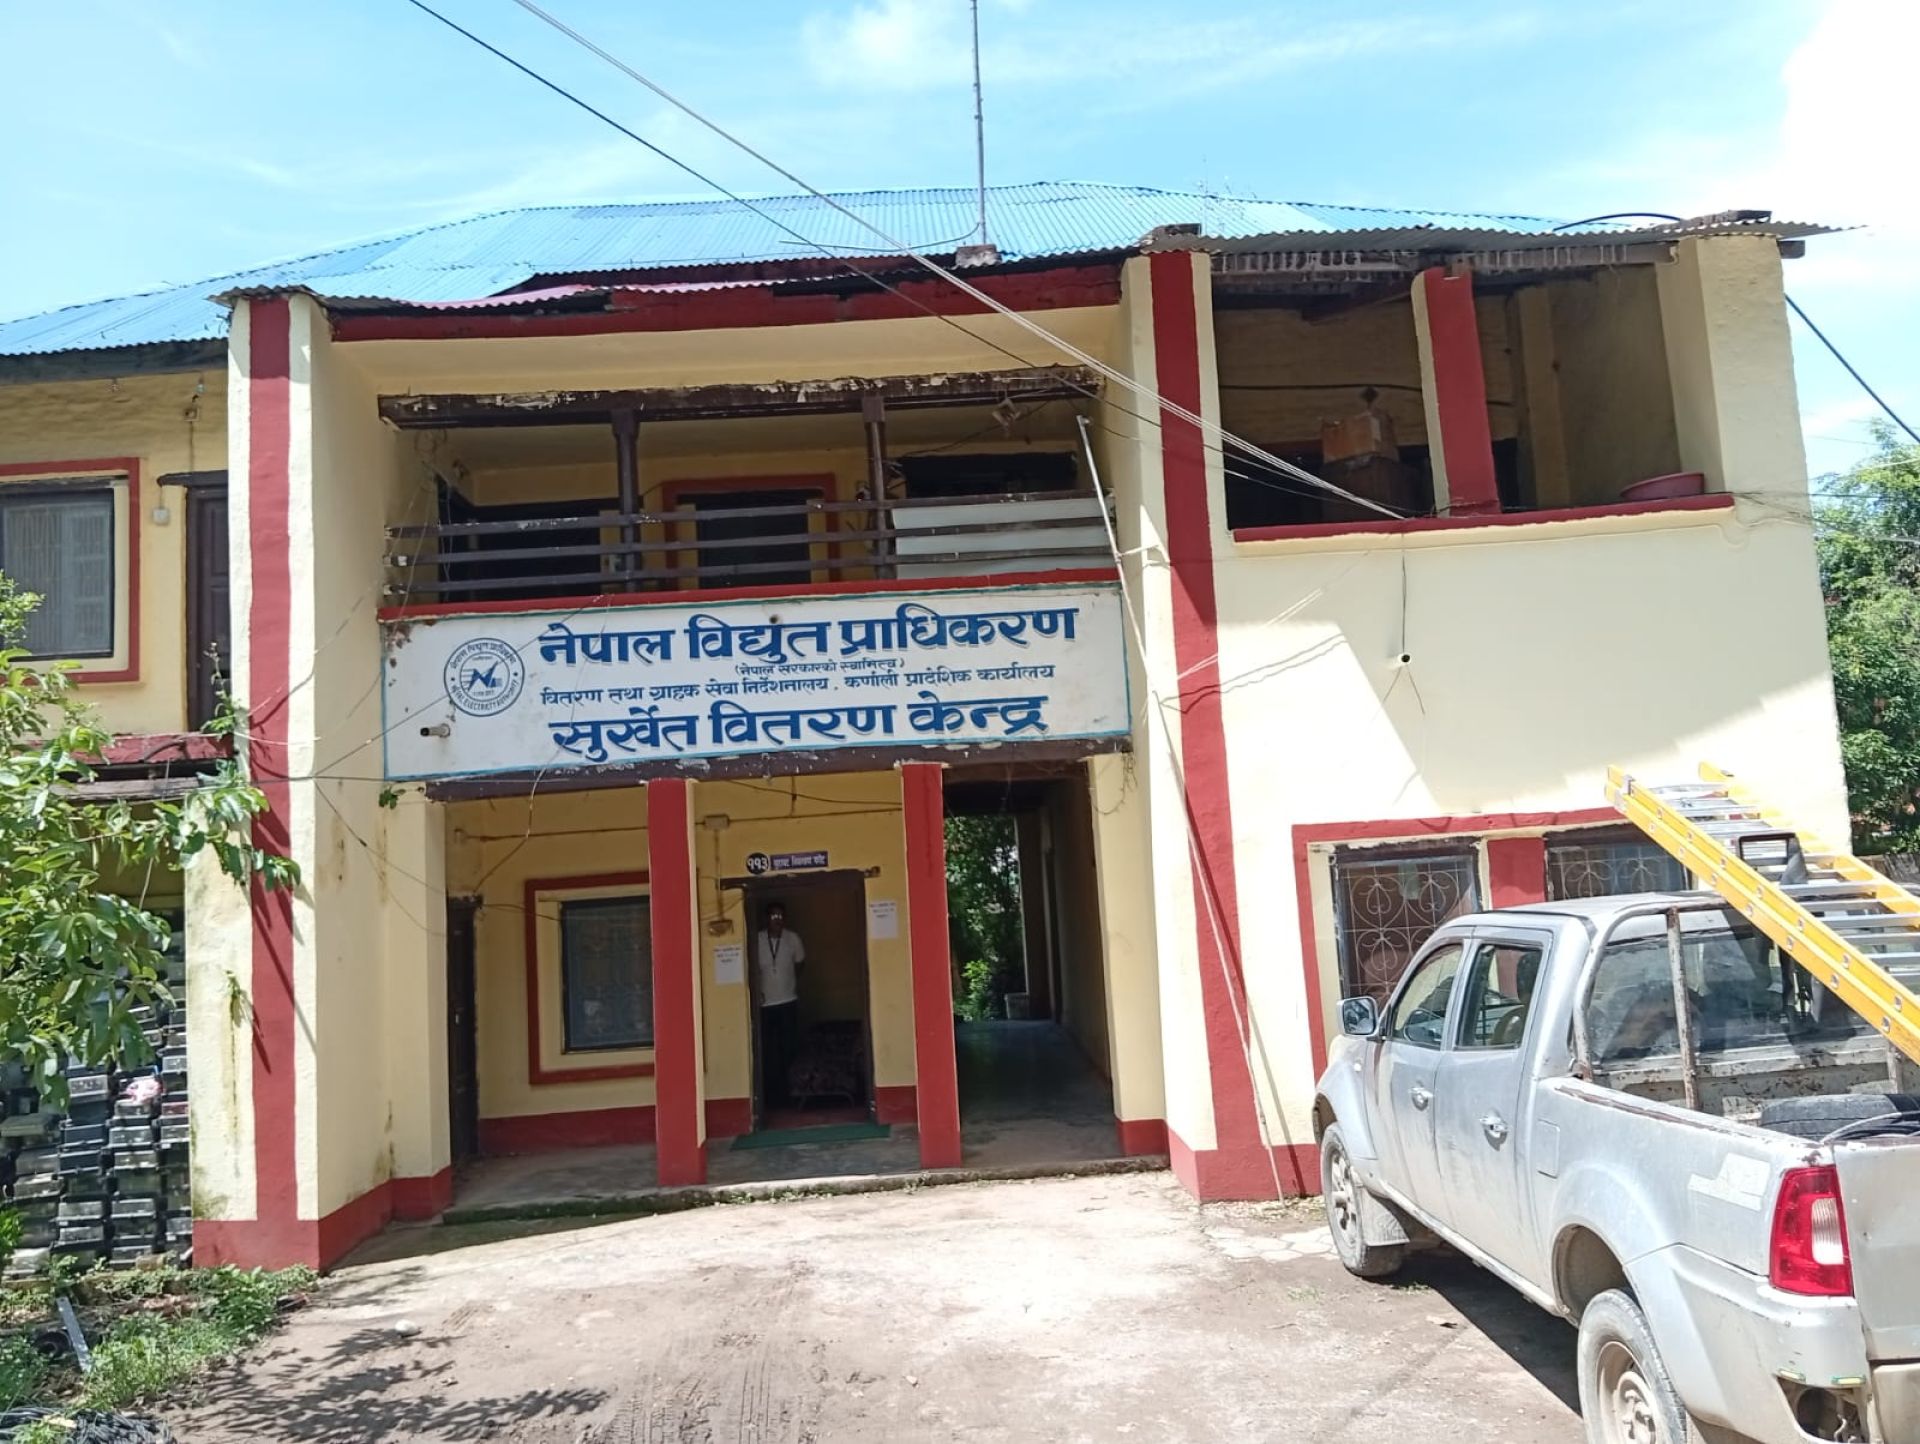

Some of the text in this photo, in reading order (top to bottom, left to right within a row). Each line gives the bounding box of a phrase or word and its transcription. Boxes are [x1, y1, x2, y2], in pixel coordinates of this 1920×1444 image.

[538, 602, 1079, 664] नेपाल विद्युत प्राधिकरण
[541, 686, 604, 707] वितरण
[609, 686, 644, 703] तथा
[649, 683, 700, 702] ग्राहक
[706, 678, 738, 696] सेवा
[844, 668, 898, 690] कर्णाली
[905, 666, 972, 688] प्रादेशिक
[977, 661, 1056, 681] कार्यालय
[778, 661, 837, 676] सरकारको
[549, 691, 1049, 763] सुर्खेत वितरण केन्द्र
[747, 857, 768, 870] ११३
